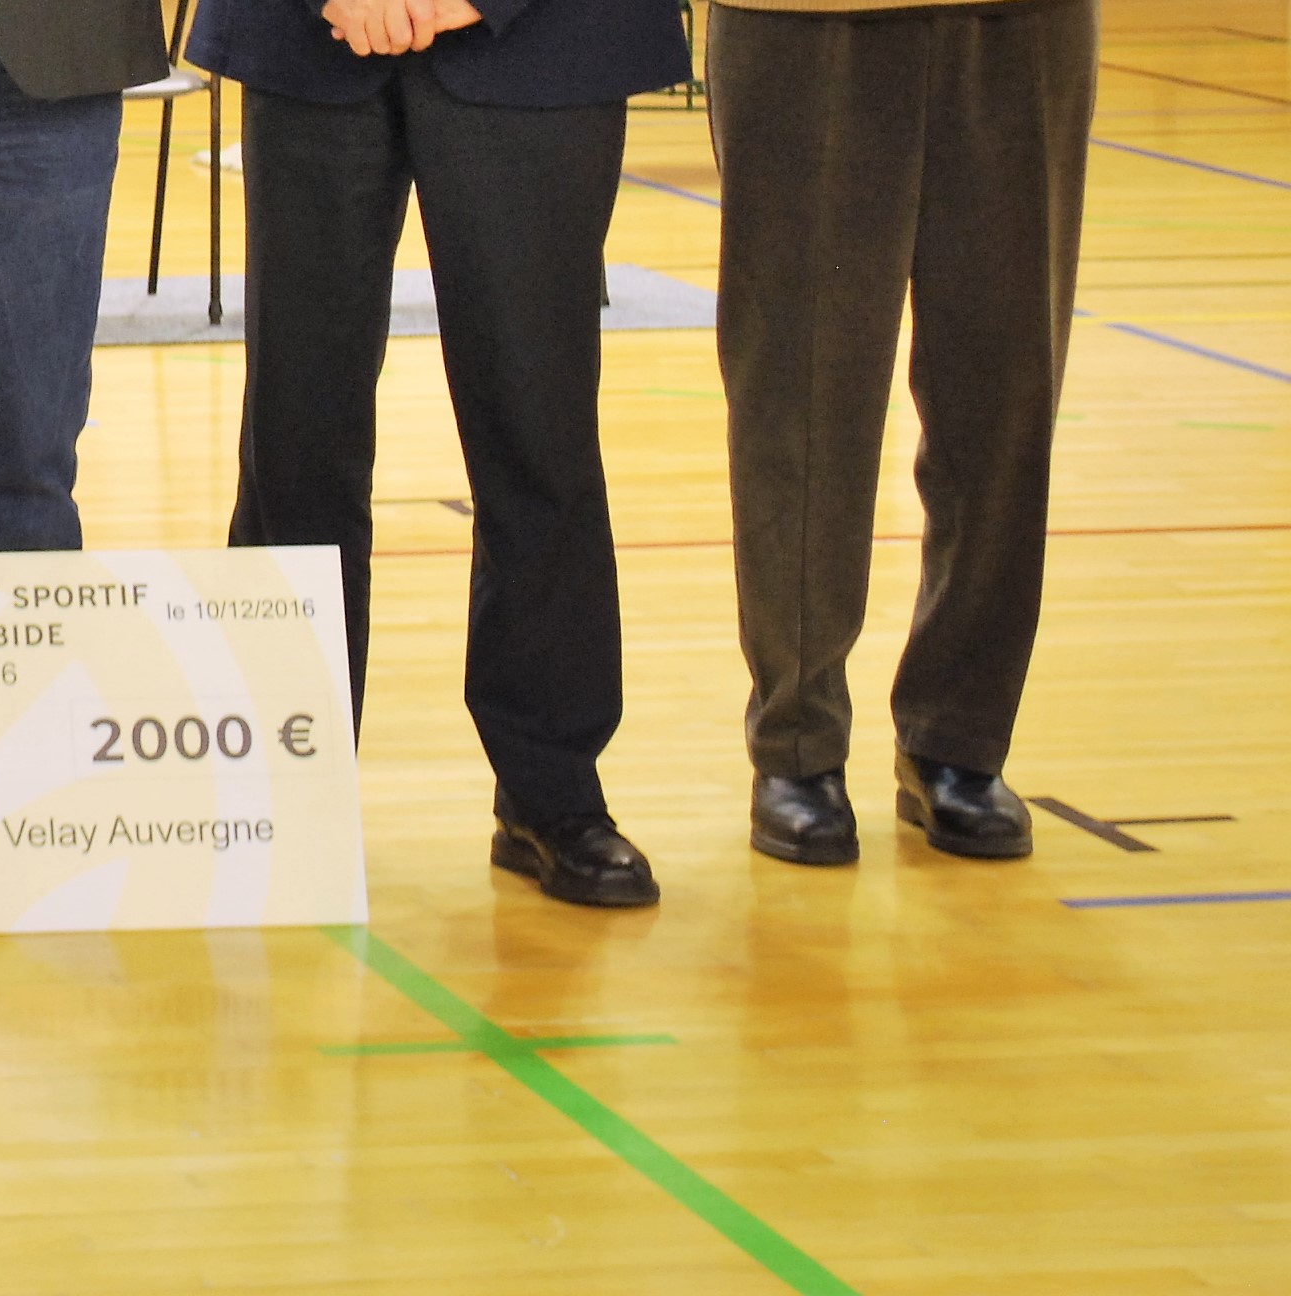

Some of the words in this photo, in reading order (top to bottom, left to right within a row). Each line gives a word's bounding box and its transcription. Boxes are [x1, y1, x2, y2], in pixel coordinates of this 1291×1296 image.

[13, 582, 149, 609] SPORTIF
[166, 601, 186, 622] le
[196, 597, 316, 621] 10/12/2016
[90, 714, 252, 763] 2000
[278, 712, 317, 759] €
[2, 815, 98, 854] Velay
[108, 814, 275, 853] Auvergne
